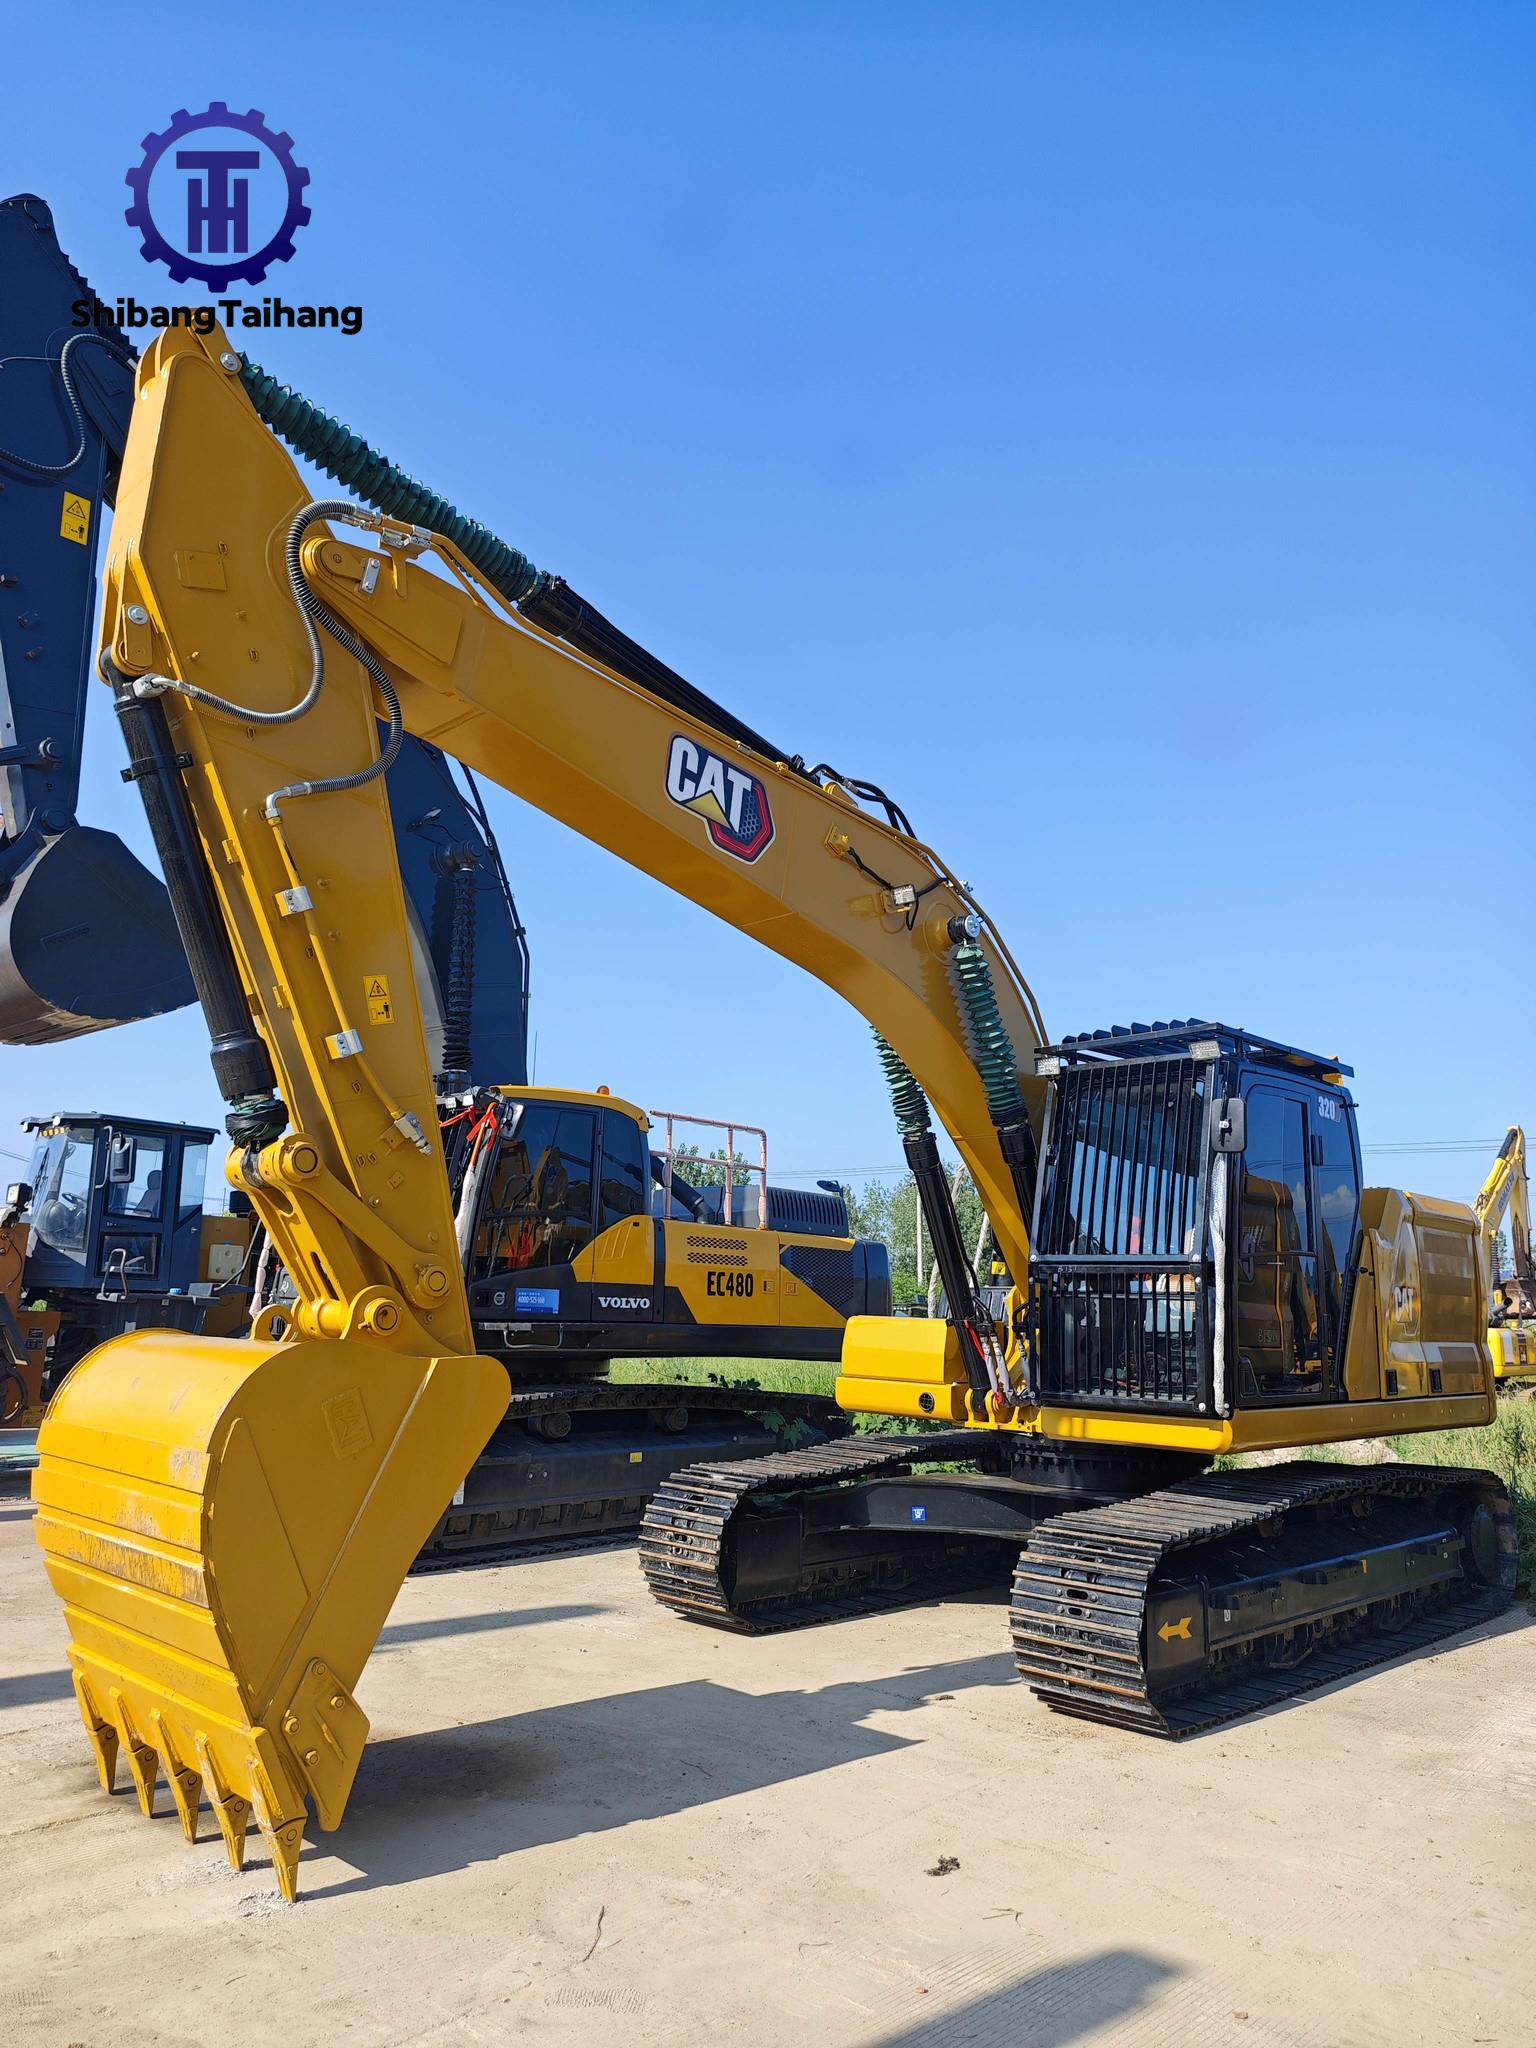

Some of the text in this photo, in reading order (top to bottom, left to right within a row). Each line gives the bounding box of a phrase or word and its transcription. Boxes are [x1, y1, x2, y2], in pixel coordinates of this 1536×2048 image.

[667, 737, 752, 834] CAT
[1318, 1095, 1336, 1120] 320
[707, 1271, 753, 1297] EC480
[598, 1296, 651, 1309] VOLVO
[1394, 1286, 1414, 1322] CAT
